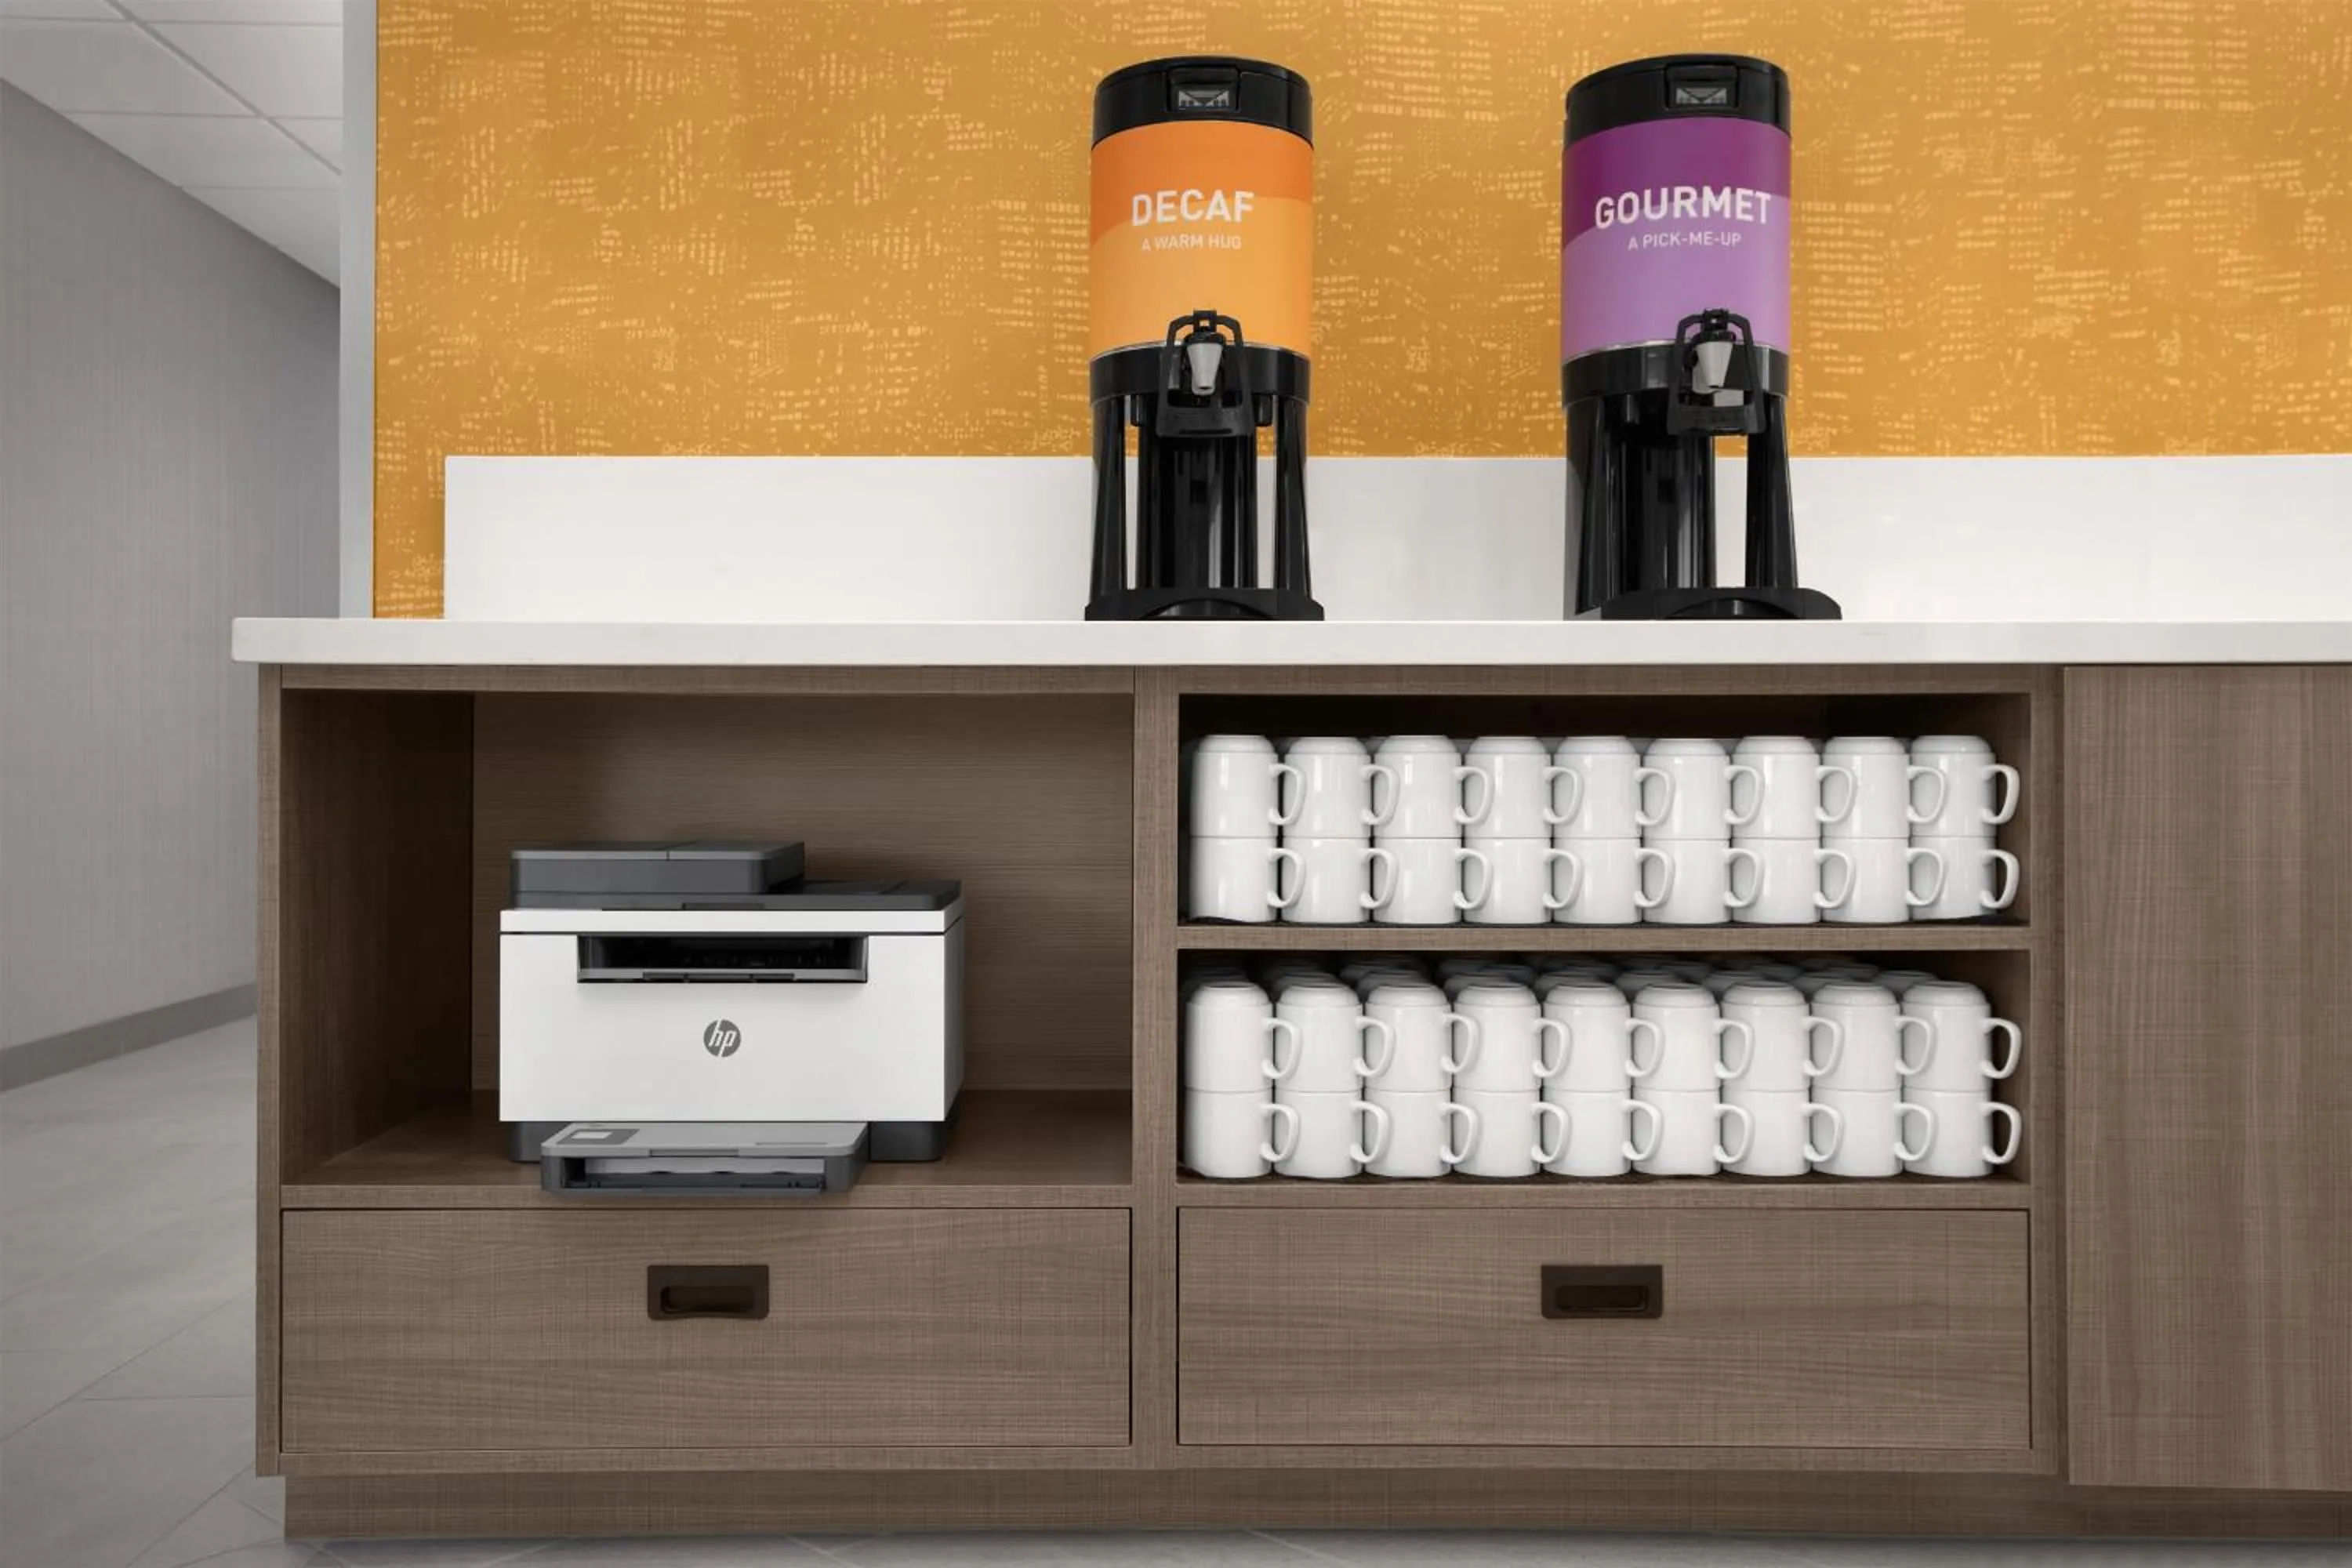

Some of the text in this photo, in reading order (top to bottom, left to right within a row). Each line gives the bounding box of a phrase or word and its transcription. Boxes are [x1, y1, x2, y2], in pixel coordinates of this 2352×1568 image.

[1131, 188, 1254, 227] DECAF
[1595, 186, 1771, 229] GOURMET
[1141, 234, 1242, 252] A WARM HUG
[1628, 231, 1742, 251] A PICK-ME-UP
[706, 1018, 739, 1058] hp
